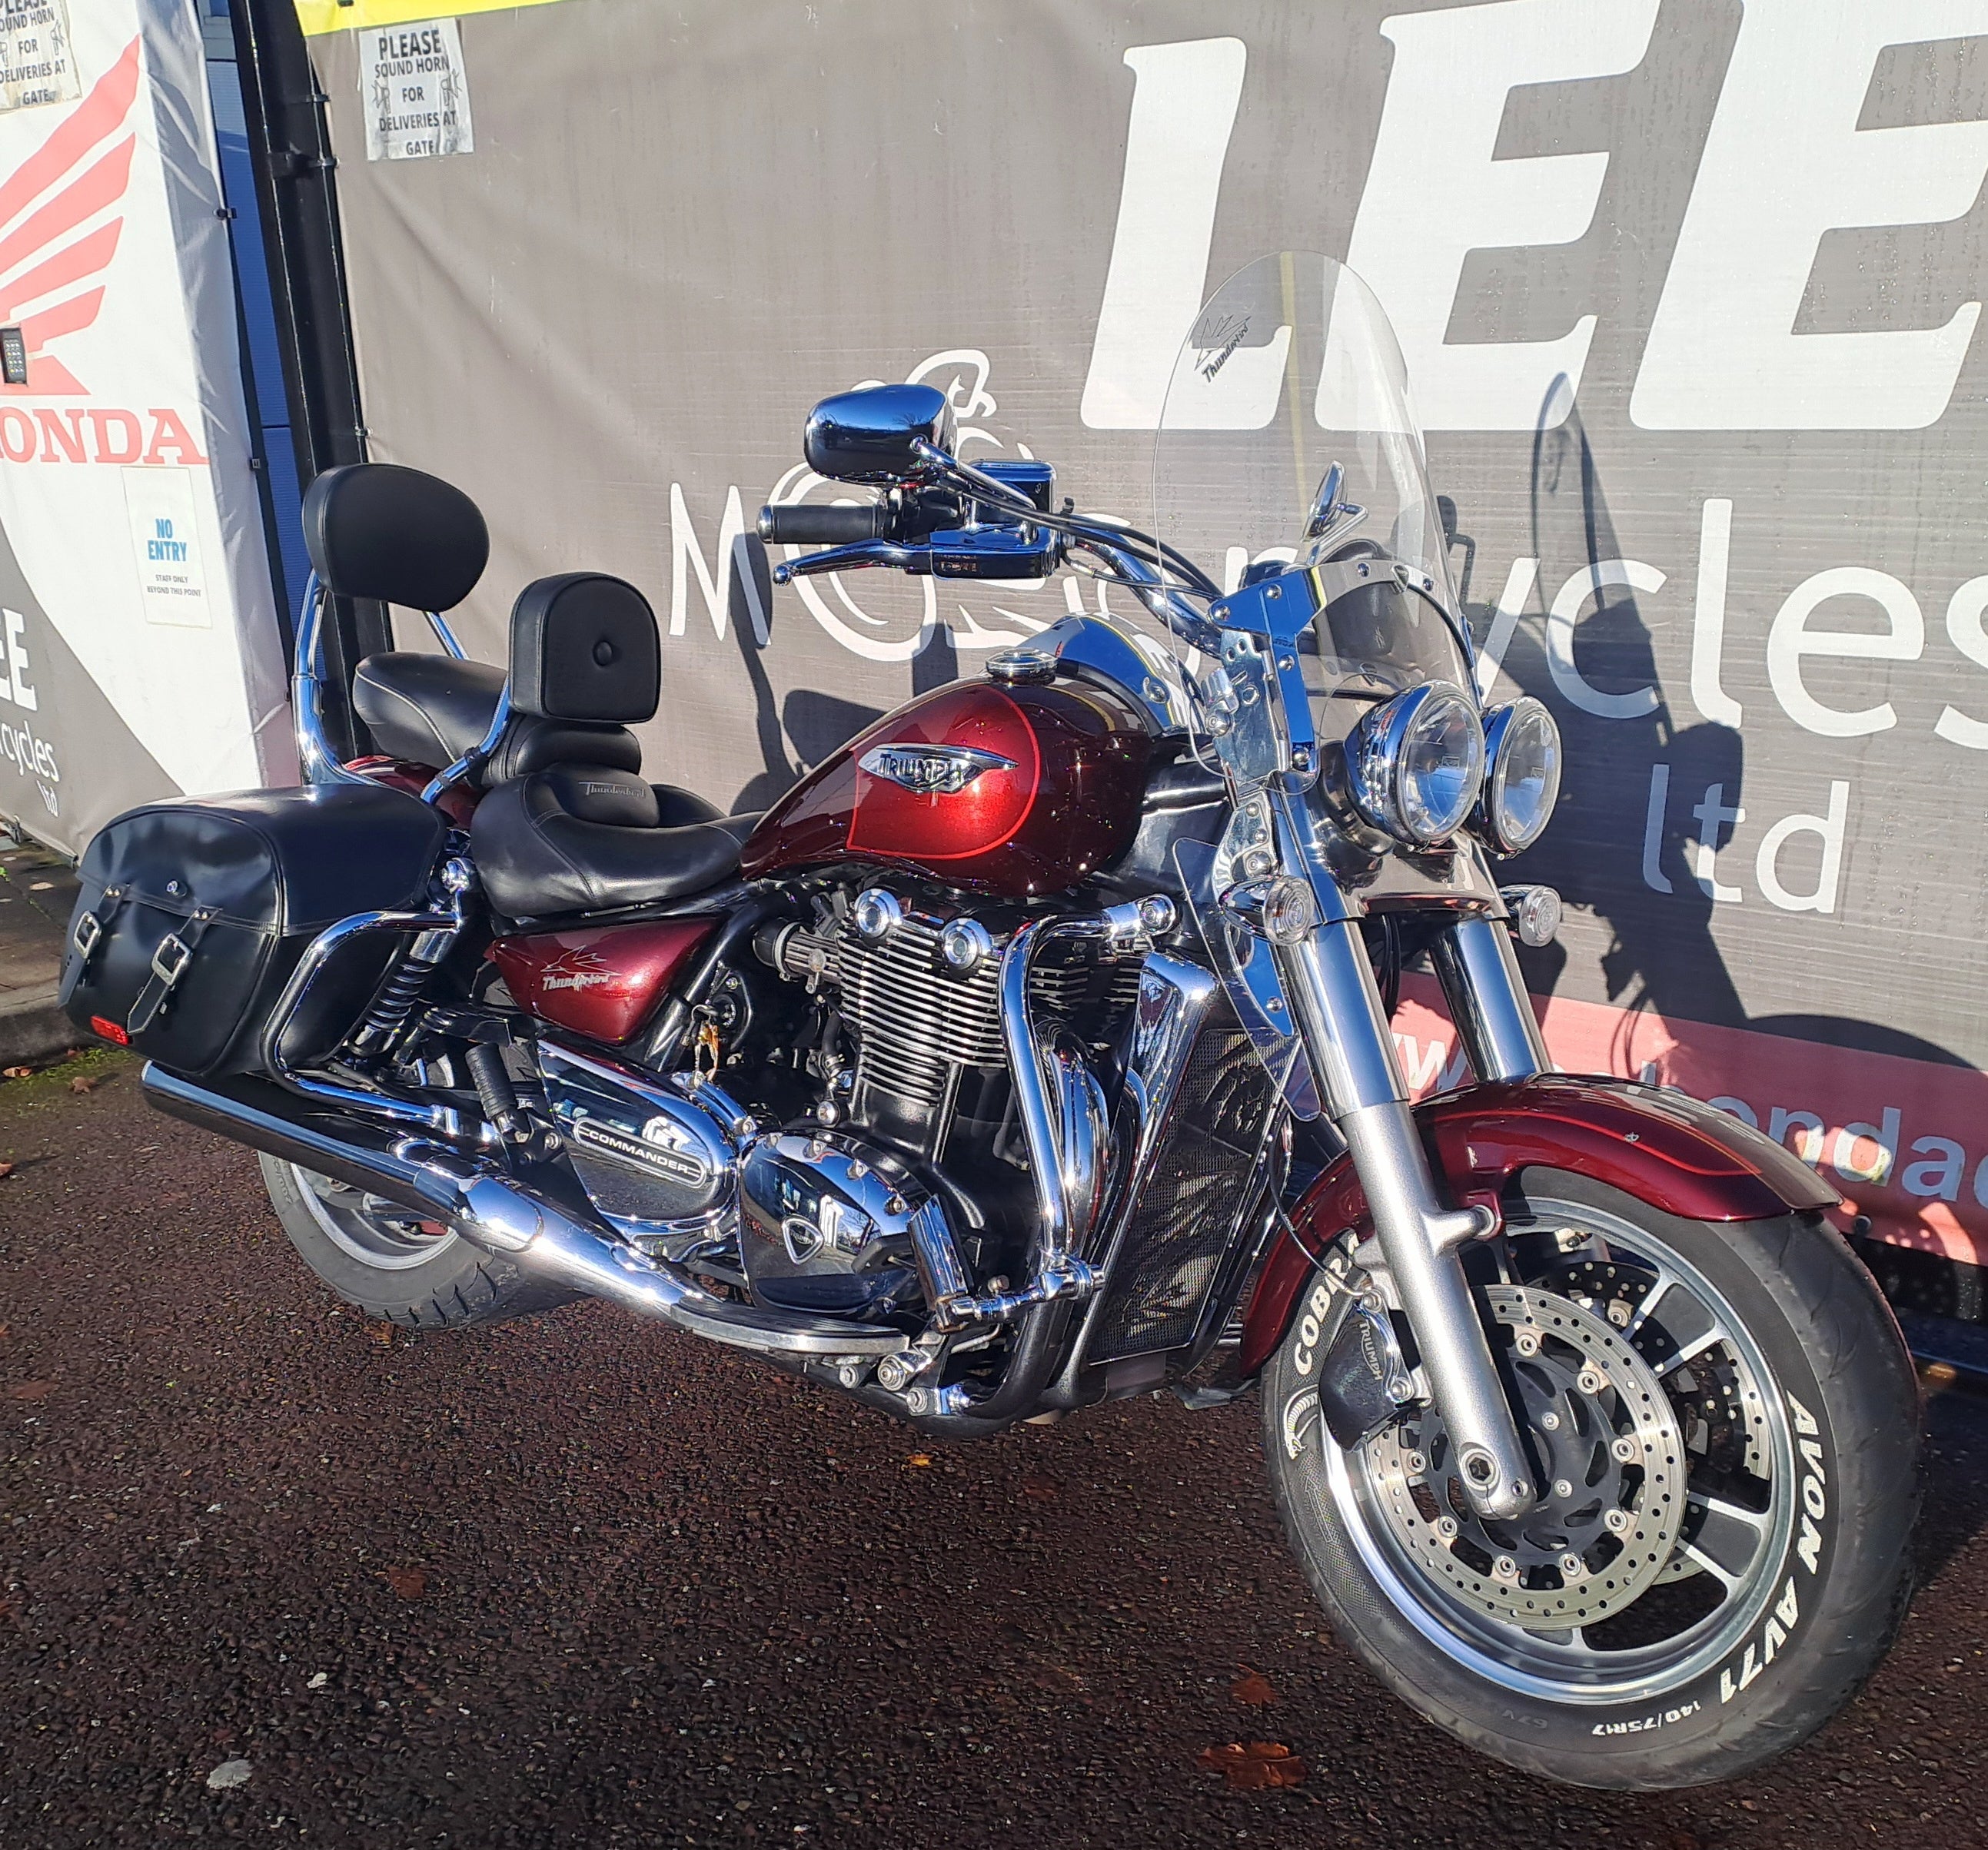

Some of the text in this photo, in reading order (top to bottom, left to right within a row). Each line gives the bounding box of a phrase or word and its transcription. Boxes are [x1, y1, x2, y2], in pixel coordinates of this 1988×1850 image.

[30, 7, 55, 26] HORN
[18, 38, 38, 55] FOR
[379, 29, 441, 60] PLEASE
[55, 59, 66, 75] AT
[375, 55, 450, 78] SOUND HORN
[23, 89, 50, 105] GATE
[401, 86, 424, 102] FOR
[379, 110, 456, 131] DELIVERIES AT
[406, 140, 434, 155] GATE
[1080, 0, 1988, 430] LEE
[0, 406, 210, 465] ONDA
[155, 518, 173, 539] NO
[147, 540, 187, 562] ENTRY
[155, 574, 188, 584] STAFF ONLY
[147, 586, 201, 598] BEYOND THIS POINT
[878, 753, 966, 787] TRIUMPH
[1642, 763, 1850, 914] ltd
[588, 1130, 689, 1174] COMMANDER
[1359, 1320, 1384, 1381] TRIUMPH
[1786, 1389, 1826, 1576] AVON
[1720, 1576, 1799, 1705] AV71
[1591, 1699, 1702, 1736] 140/75R17
